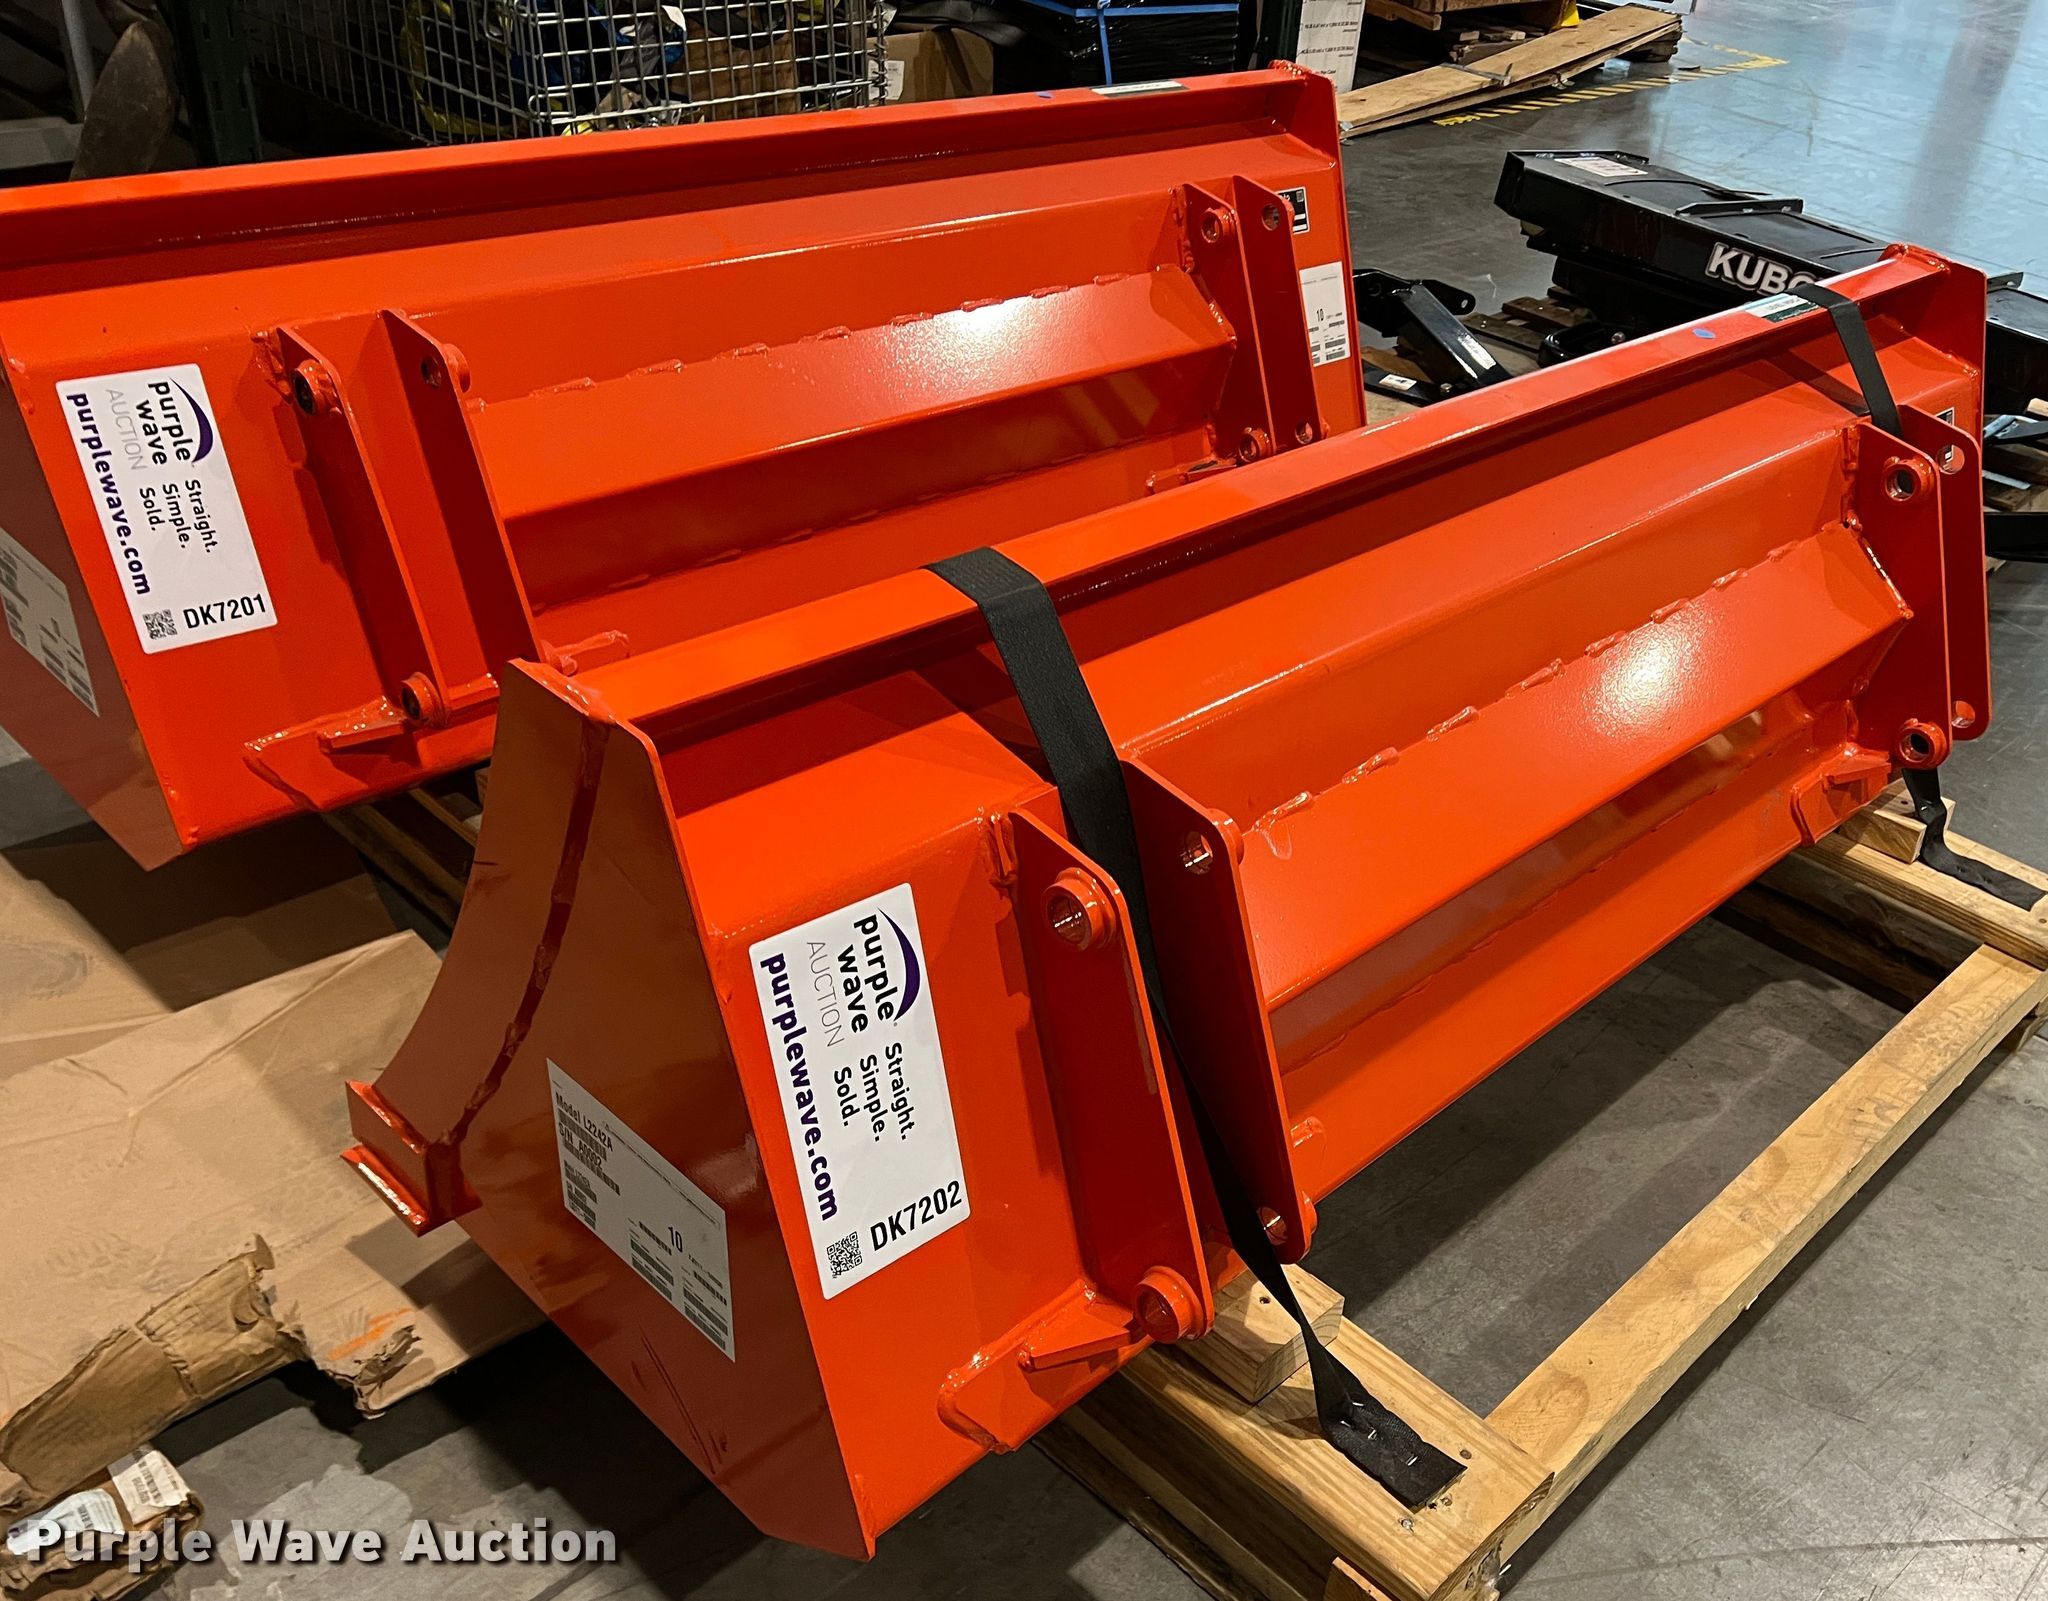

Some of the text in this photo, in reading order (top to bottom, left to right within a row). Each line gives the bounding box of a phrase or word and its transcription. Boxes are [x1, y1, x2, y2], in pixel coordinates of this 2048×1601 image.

[1316, 308, 1324, 322] 10
[106, 389, 146, 470] AUCTION
[136, 400, 166, 465] wave
[148, 381, 193, 461] purple
[66, 393, 150, 594] purplewave.com
[140, 487, 165, 531] Sold.
[162, 483, 192, 548] Simple.
[186, 479, 218, 553] Straight.
[183, 593, 265, 628] DK7201
[806, 941, 844, 1047] AUCTION
[838, 944, 868, 1033] wave
[854, 914, 899, 1021] purple
[556, 1091, 613, 1153] Model L2242A
[760, 952, 838, 1220] purplewave.com
[834, 1066, 860, 1126] Sold.
[860, 1054, 887, 1142] Simple.
[885, 1042, 914, 1140] Straight.
[558, 1122, 574, 1145] S/N
[668, 1226, 683, 1253] 10
[870, 1180, 962, 1252] DK7202
